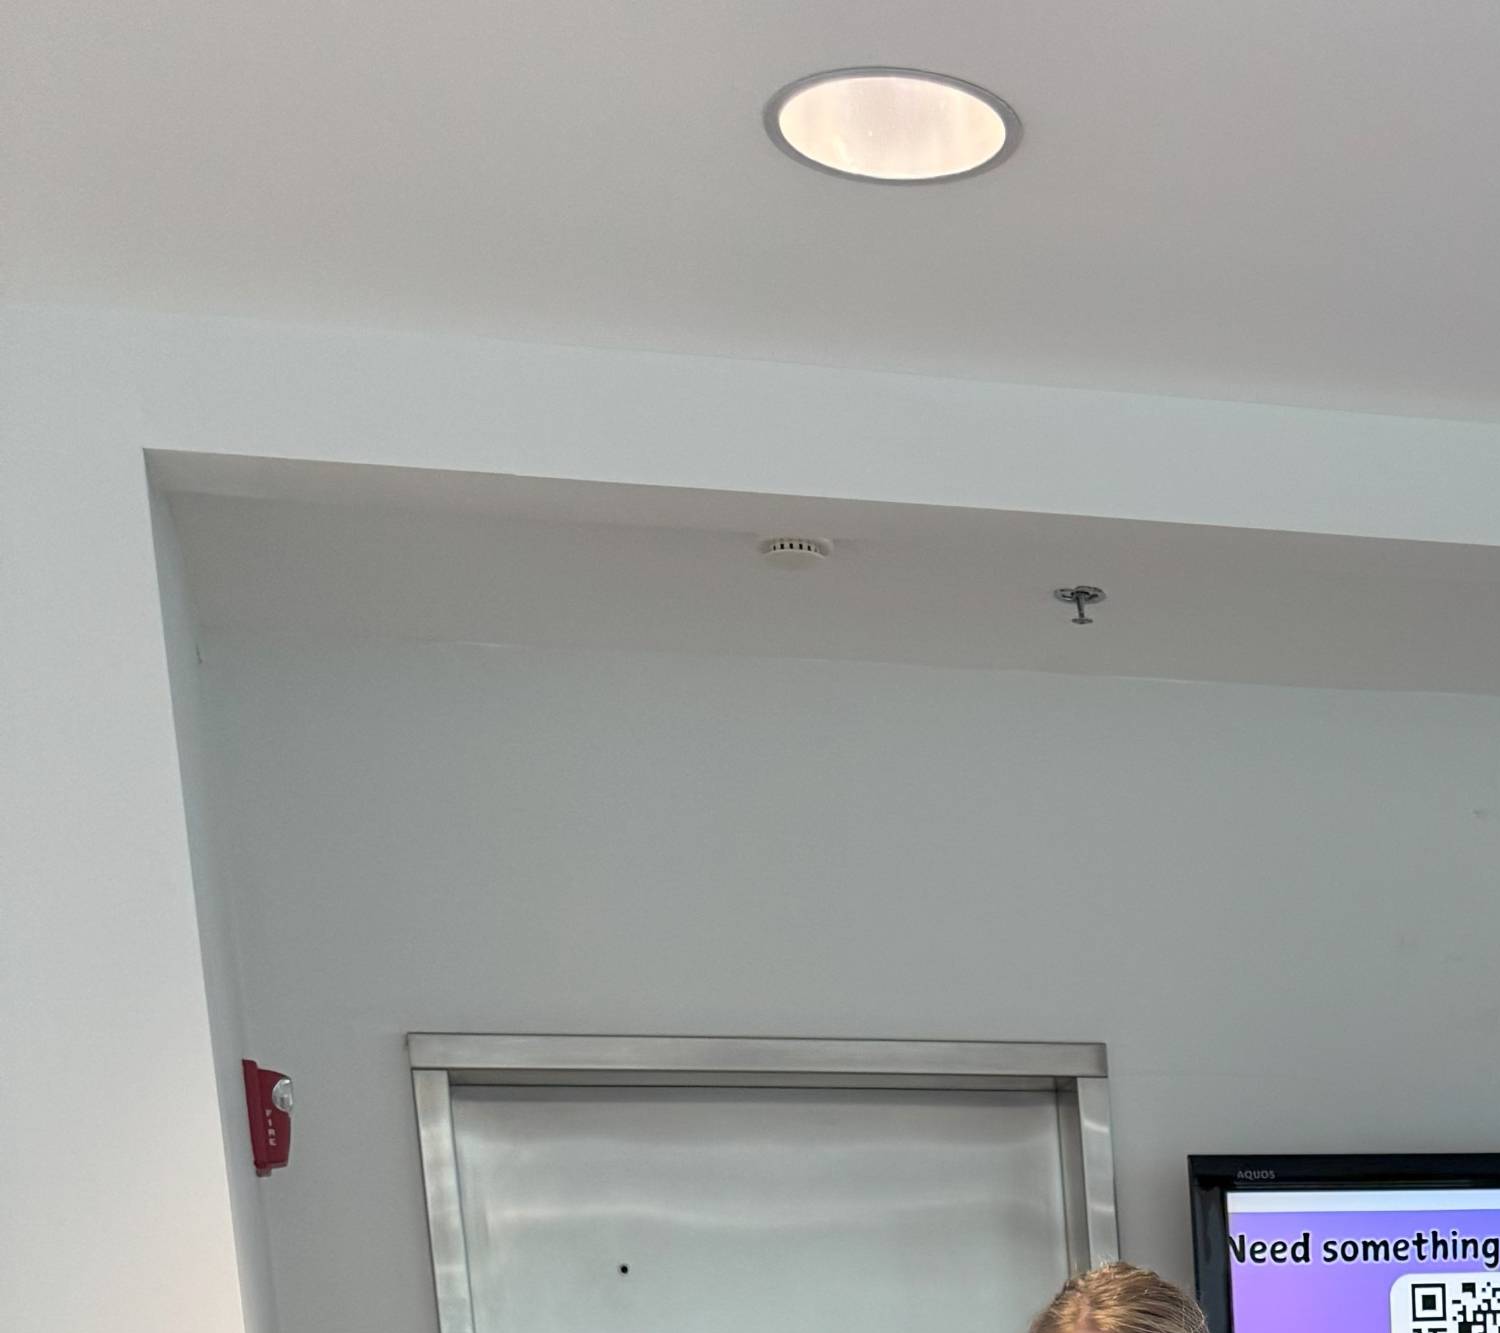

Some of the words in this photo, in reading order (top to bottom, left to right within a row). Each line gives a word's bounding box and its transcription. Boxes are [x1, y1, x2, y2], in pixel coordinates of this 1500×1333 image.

[264, 1109, 277, 1146] FIRE
[1236, 1170, 1276, 1180] AQUOS
[1229, 1232, 1310, 1263] Need
[1323, 1231, 1500, 1268] something
